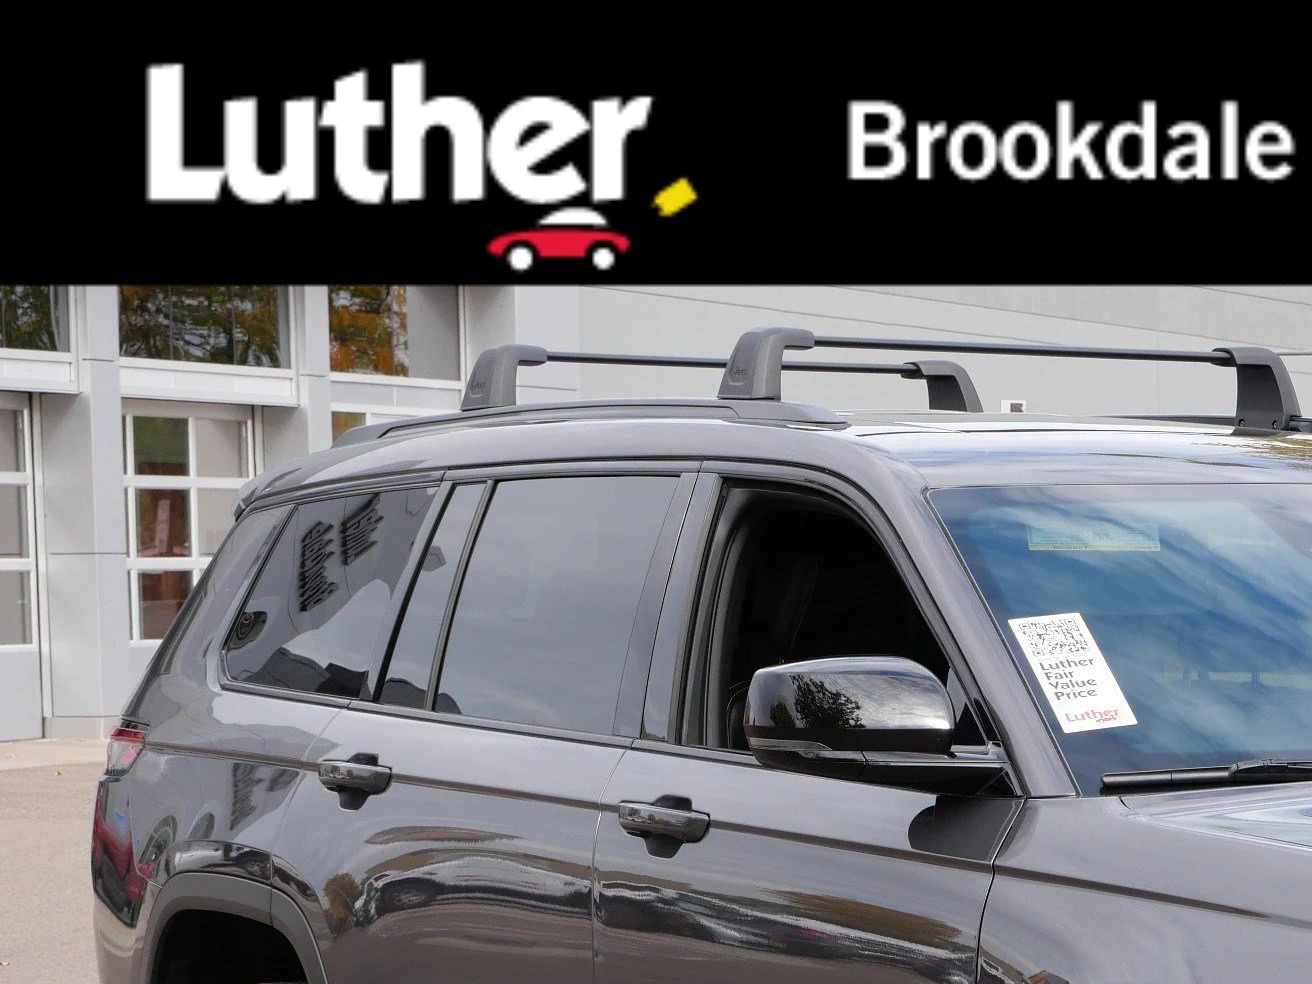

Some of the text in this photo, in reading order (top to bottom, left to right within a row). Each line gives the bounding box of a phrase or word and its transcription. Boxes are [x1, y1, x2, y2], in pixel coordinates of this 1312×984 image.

[1039, 658, 1094, 671] Luther
[1044, 670, 1074, 681] Fair
[1048, 678, 1098, 690] Value
[1054, 688, 1098, 701] Price
[1065, 709, 1120, 723] Luther
